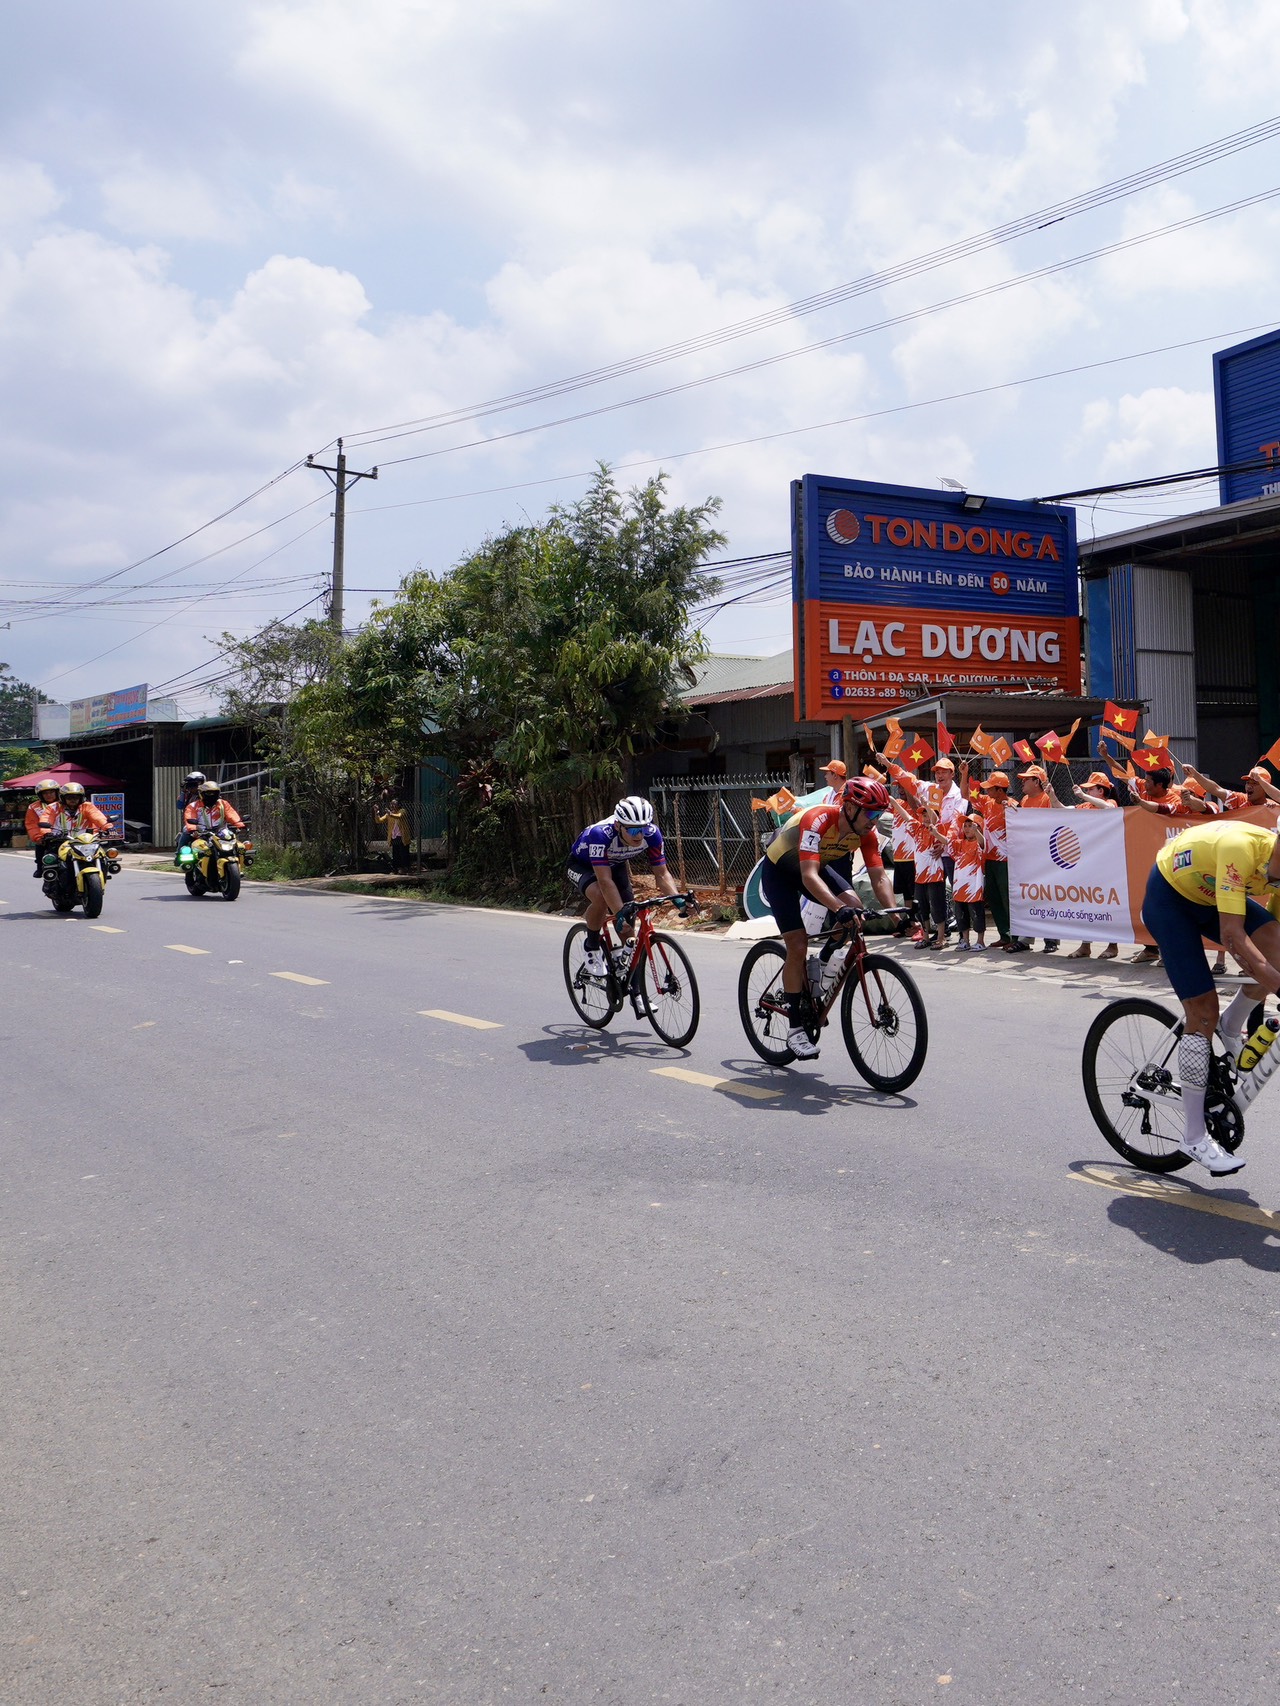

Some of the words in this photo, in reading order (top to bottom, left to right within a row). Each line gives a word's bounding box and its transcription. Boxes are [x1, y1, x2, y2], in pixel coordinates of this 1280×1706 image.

[864, 515, 937, 548] TON
[844, 562, 874, 579] BẢO
[880, 565, 922, 583] HÀNH
[927, 570, 952, 586] LÊN
[958, 571, 984, 588] ĐẾN
[993, 577, 1008, 590] 50
[1016, 577, 1048, 593] NĂM
[828, 619, 905, 664] LẠC
[922, 624, 1060, 663] DƯƠNG
[844, 669, 877, 681] THÔN
[880, 672, 886, 681] 1
[888, 673, 904, 683] ĐẠ
[908, 673, 932, 684] SAR,
[845, 687, 876, 697] 02633
[808, 835, 815, 846] 7
[591, 845, 604, 857] 37
[1020, 883, 1052, 901] TON
[1029, 907, 1046, 919] cùng
[1046, 907, 1059, 920] xây
[1059, 908, 1075, 921] cuộc
[1076, 909, 1094, 922] sống
[1094, 912, 1112, 921] xanh
